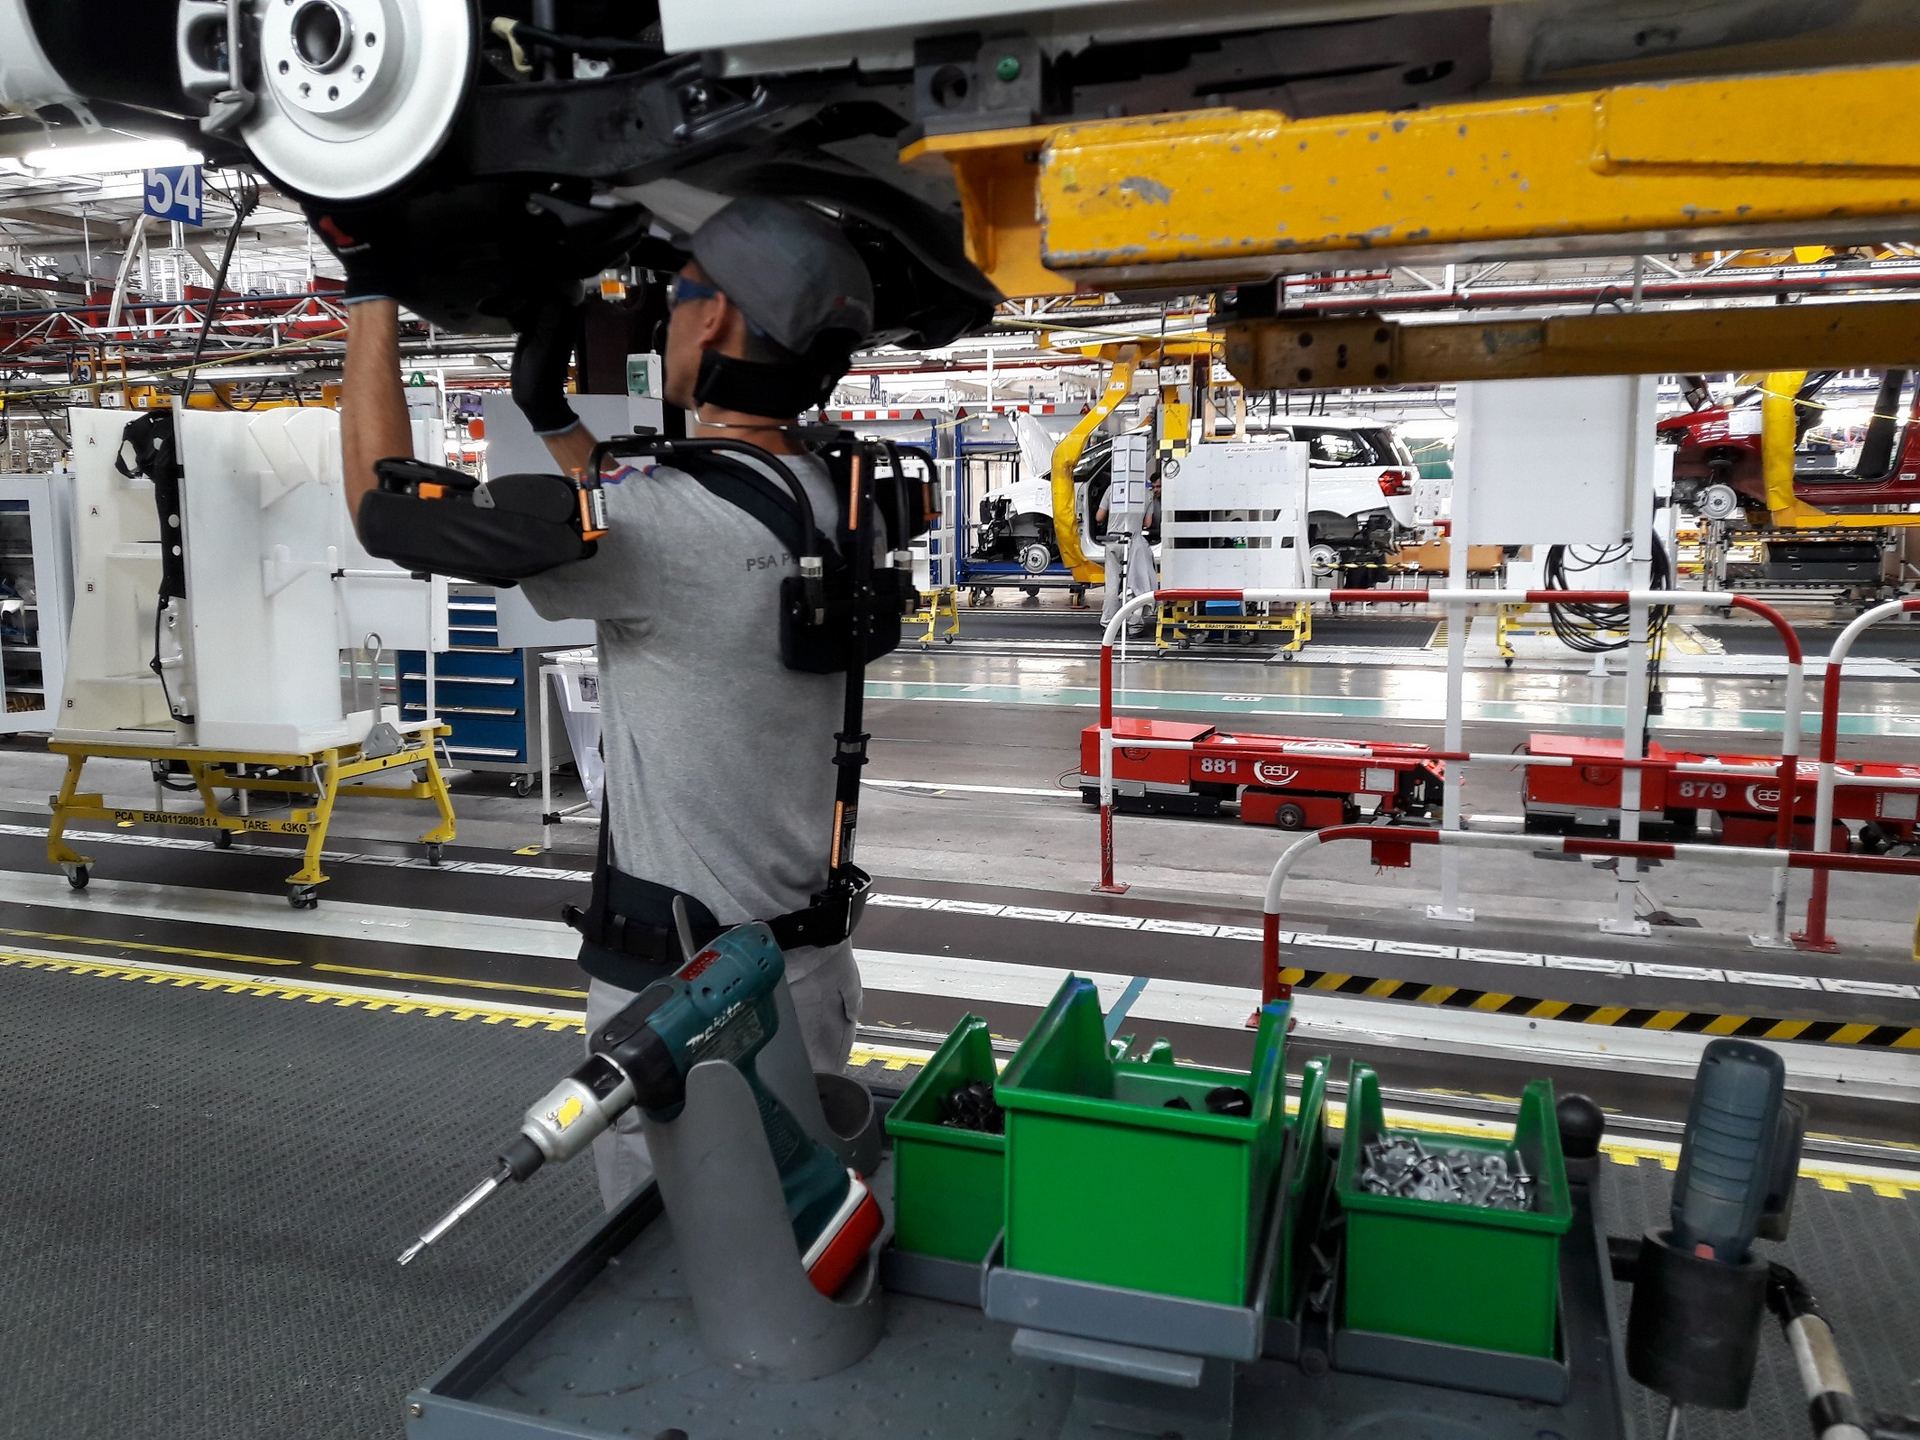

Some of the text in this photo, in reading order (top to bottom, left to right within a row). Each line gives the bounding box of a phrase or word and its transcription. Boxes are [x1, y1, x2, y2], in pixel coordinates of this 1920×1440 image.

[147, 165, 200, 220] 54
[412, 374, 421, 385] A
[89, 437, 96, 445] A
[91, 507, 98, 515] A
[746, 554, 778, 572] PSA
[87, 583, 94, 592] B
[66, 699, 73, 708] B
[1201, 757, 1237, 774] 881
[1679, 780, 1727, 799] 879
[114, 811, 135, 821] PCA
[241, 820, 271, 831] TARE:
[281, 823, 307, 833] 43KG
[686, 1001, 745, 1053] makita
